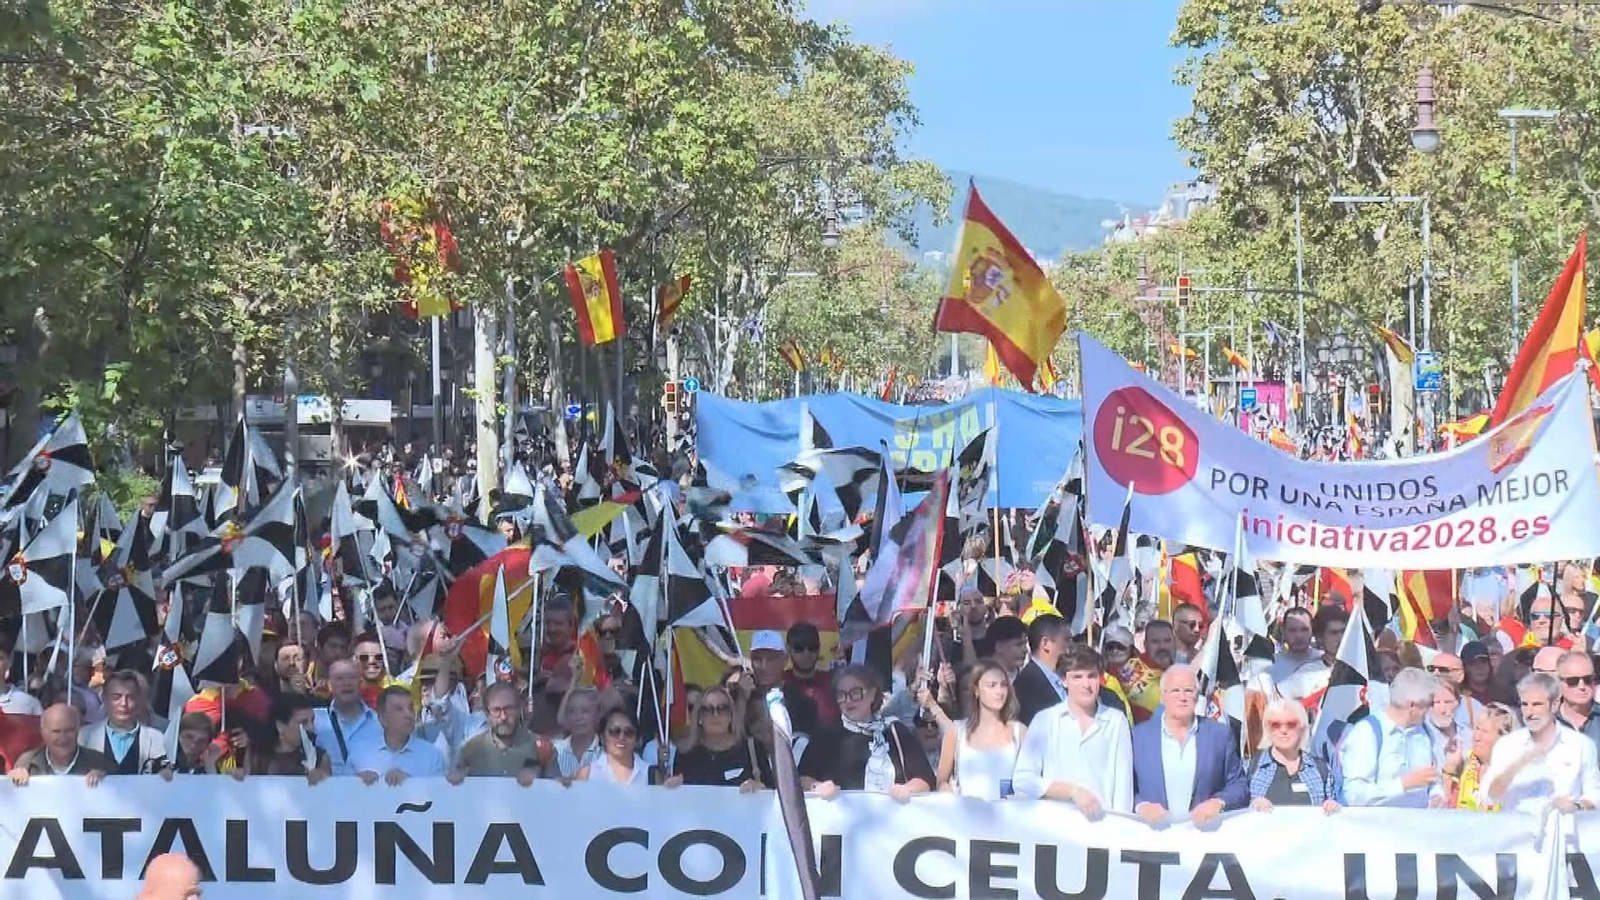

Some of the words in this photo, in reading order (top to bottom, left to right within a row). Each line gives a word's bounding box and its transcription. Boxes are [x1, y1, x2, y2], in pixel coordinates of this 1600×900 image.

[1111, 406, 1185, 467] i28
[1211, 468, 1269, 500] POR
[1280, 484, 1343, 513] UNA
[1354, 493, 1467, 518] ESPAÑA
[1477, 469, 1569, 507] MEJOR
[1320, 475, 1438, 501] UNIDOS
[1242, 507, 1550, 551] iniciativa2028.es
[893, 836, 1286, 900] CEUTA
